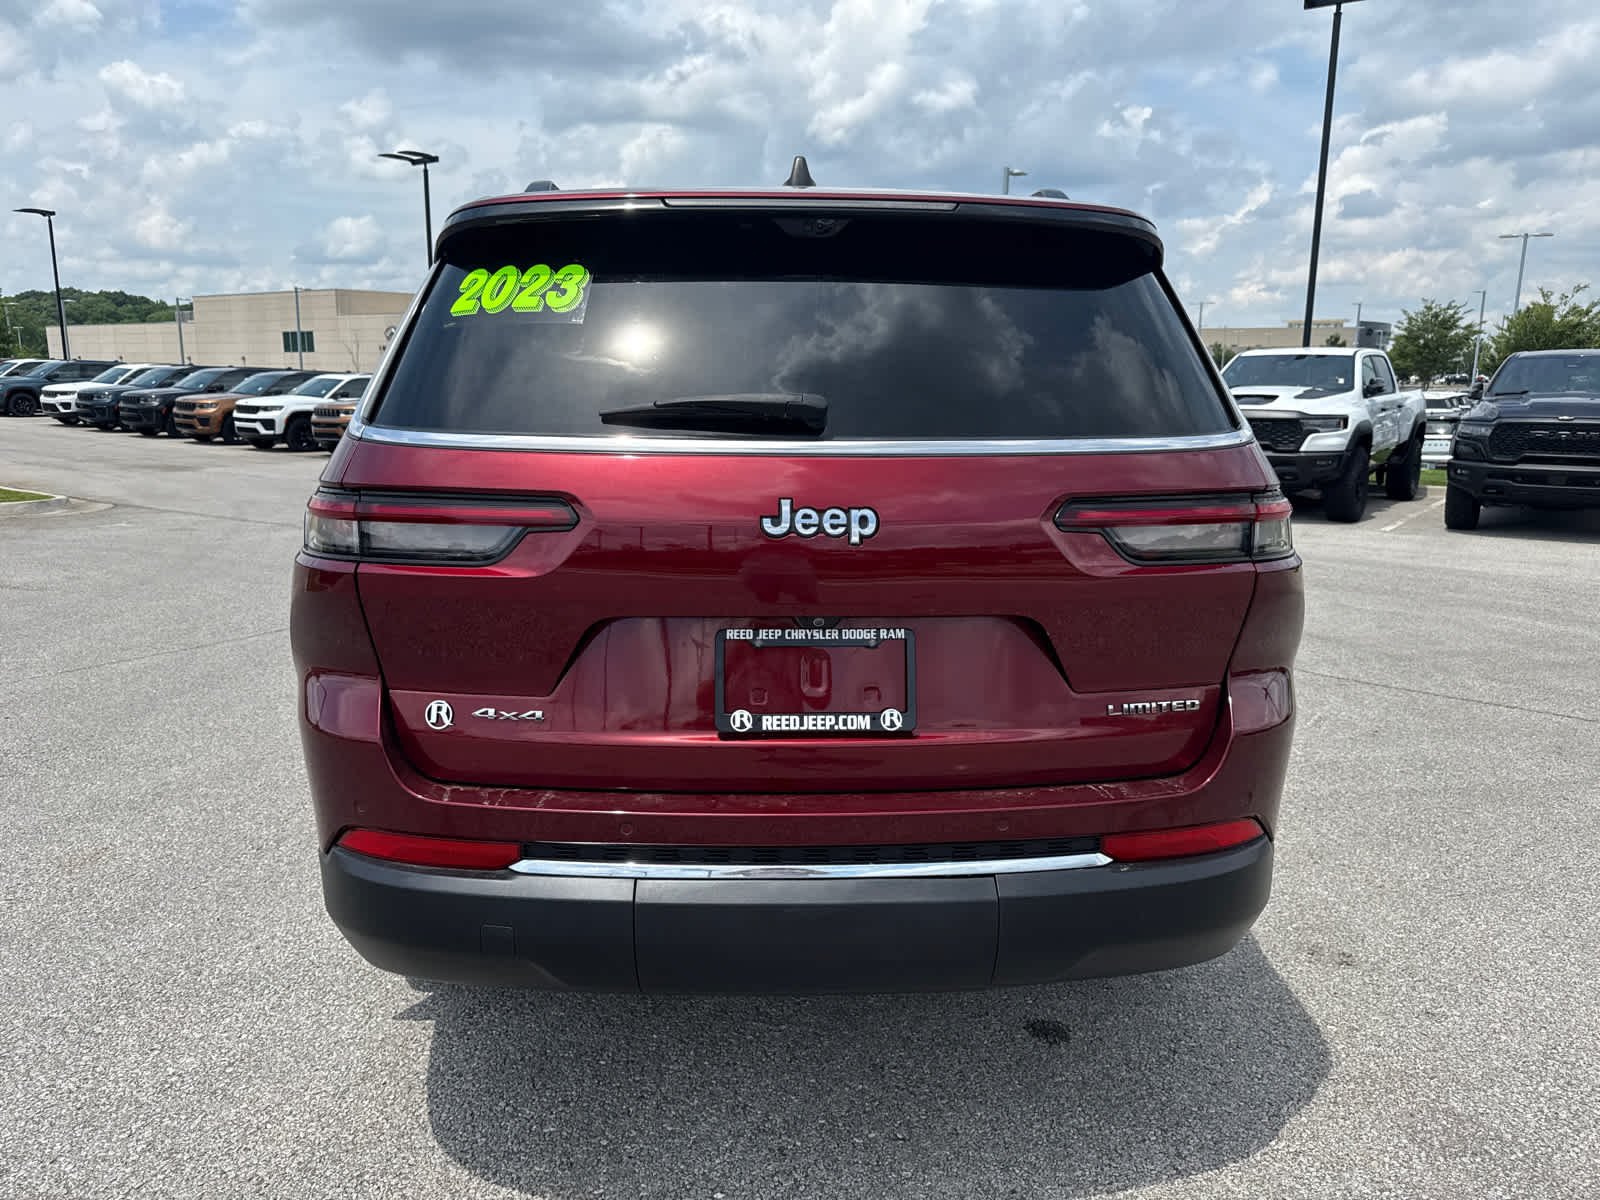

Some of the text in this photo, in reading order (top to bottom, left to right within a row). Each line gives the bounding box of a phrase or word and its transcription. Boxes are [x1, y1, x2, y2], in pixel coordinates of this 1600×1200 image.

[450, 263, 590, 317] 2023
[760, 497, 879, 545] Jeep
[726, 628, 905, 640] REED JEEP CHRYSLER DODGE RAM
[472, 708, 545, 721] 4x4
[1107, 699, 1200, 716] LIMITED
[762, 715, 871, 731] REEDJEEP.COM
